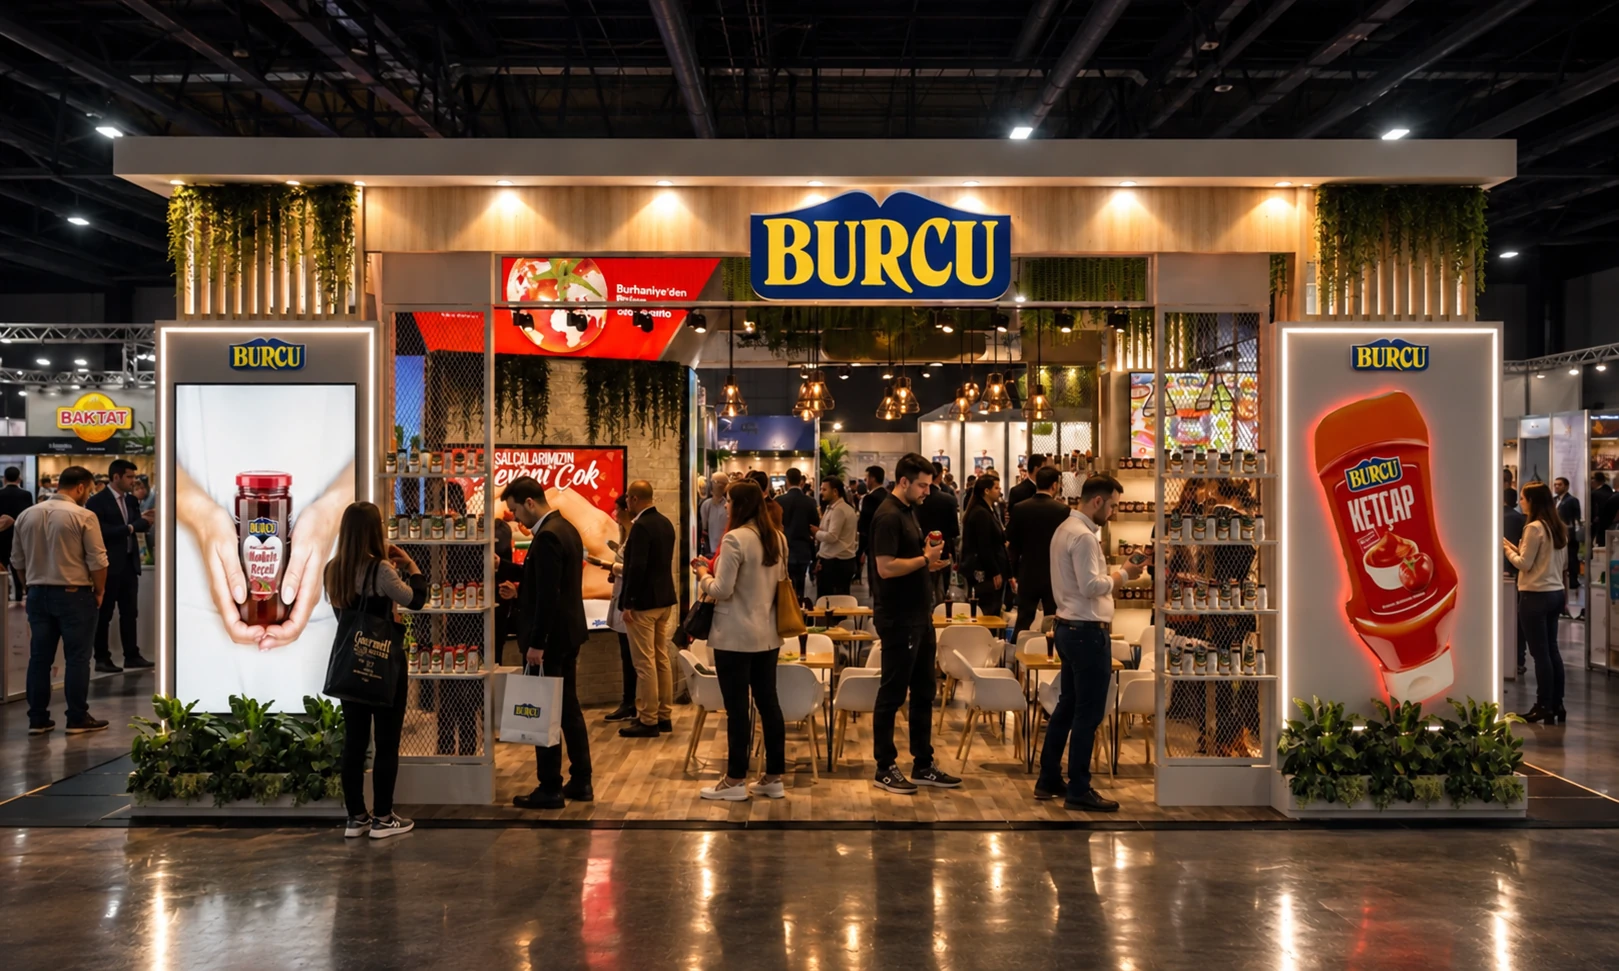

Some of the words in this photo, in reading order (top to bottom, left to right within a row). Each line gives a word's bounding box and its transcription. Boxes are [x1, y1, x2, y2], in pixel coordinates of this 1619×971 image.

[763, 217, 998, 293] BURCU
[616, 284, 687, 297] Burhaniye'den
[233, 346, 301, 370] BURCU
[1356, 346, 1427, 371] BURCU
[60, 411, 127, 425] BAKTAT
[1349, 460, 1398, 488] BURCU
[1347, 484, 1415, 533] KETÇAP
